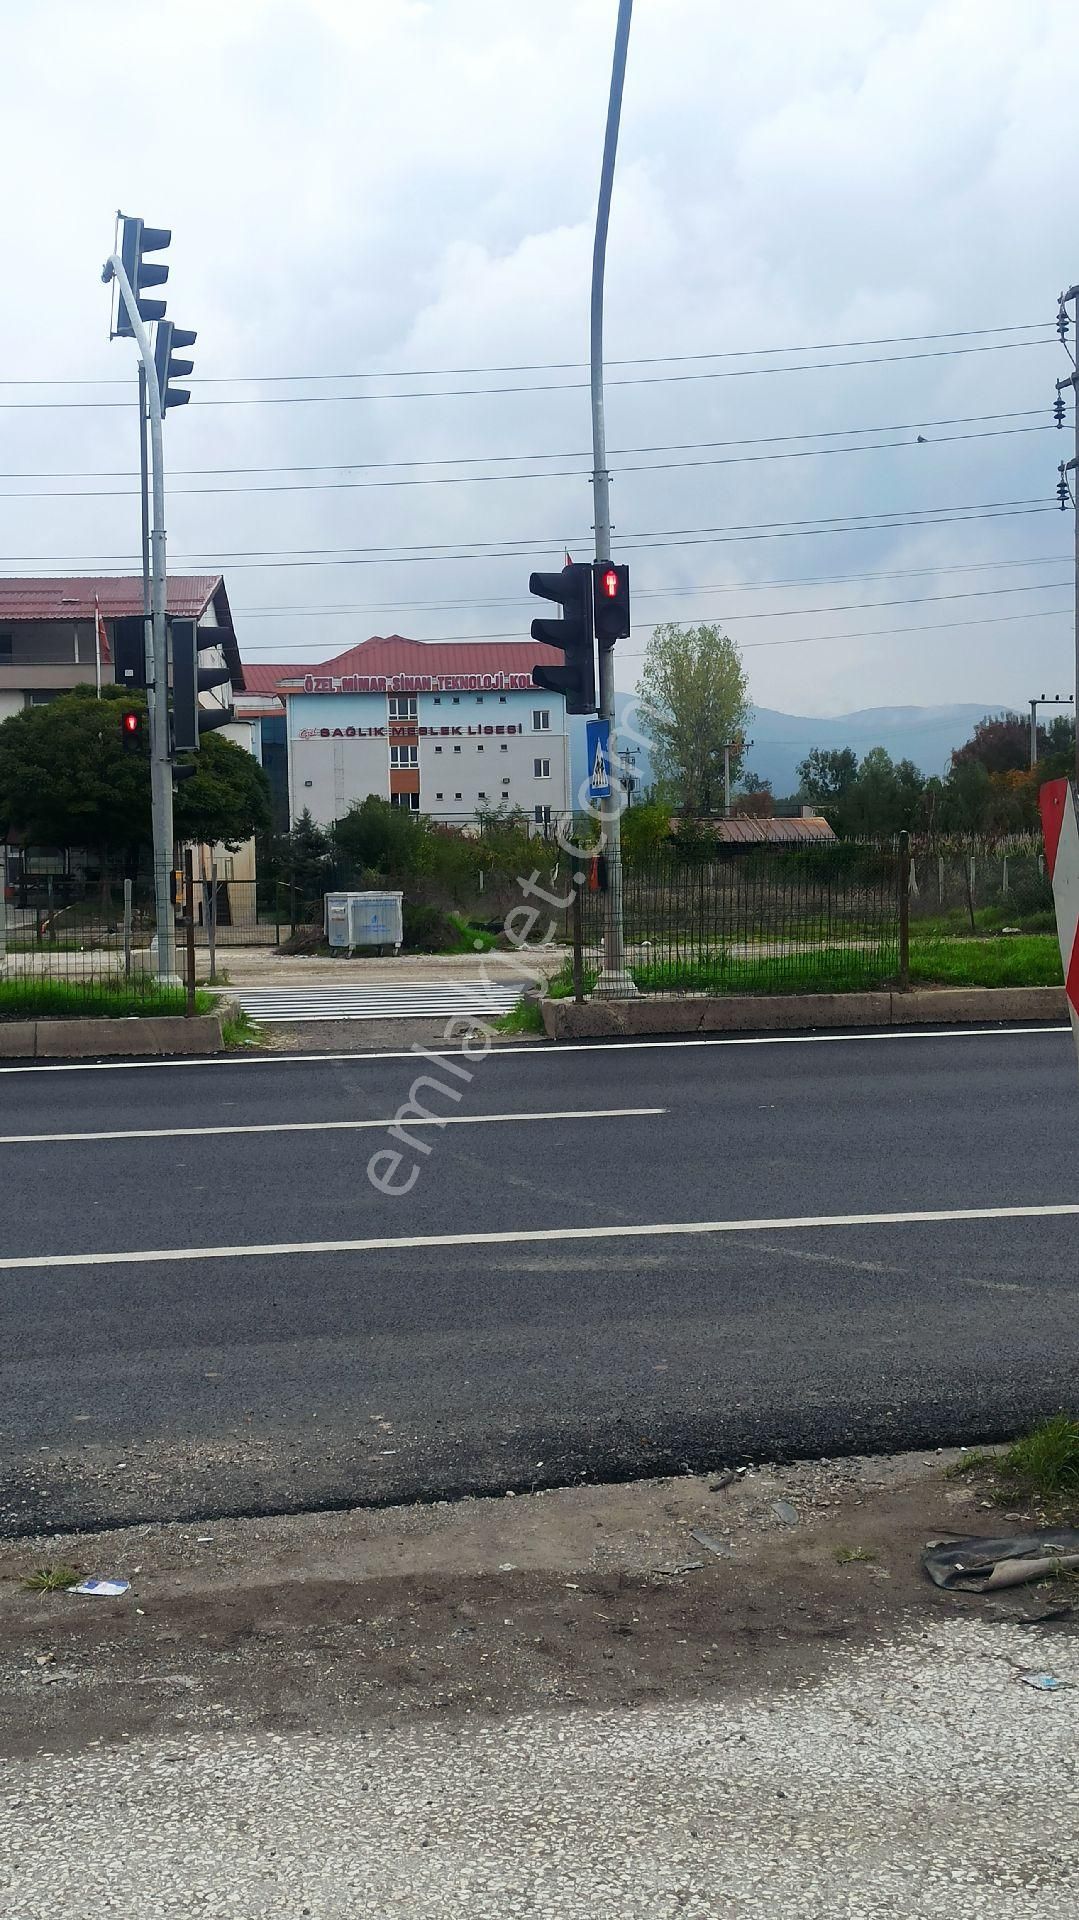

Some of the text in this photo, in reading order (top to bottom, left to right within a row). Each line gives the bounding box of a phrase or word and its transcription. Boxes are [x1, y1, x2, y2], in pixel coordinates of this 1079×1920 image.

[303, 674, 336, 692] ÖZEL
[341, 673, 386, 691] MİMAR
[392, 673, 432, 691] SİNAN
[437, 670, 504, 690] TEKNOLOJİ
[320, 726, 385, 737] SAĞLIK
[391, 726, 462, 736] MESLEK
[468, 723, 522, 735] LİSESİ
